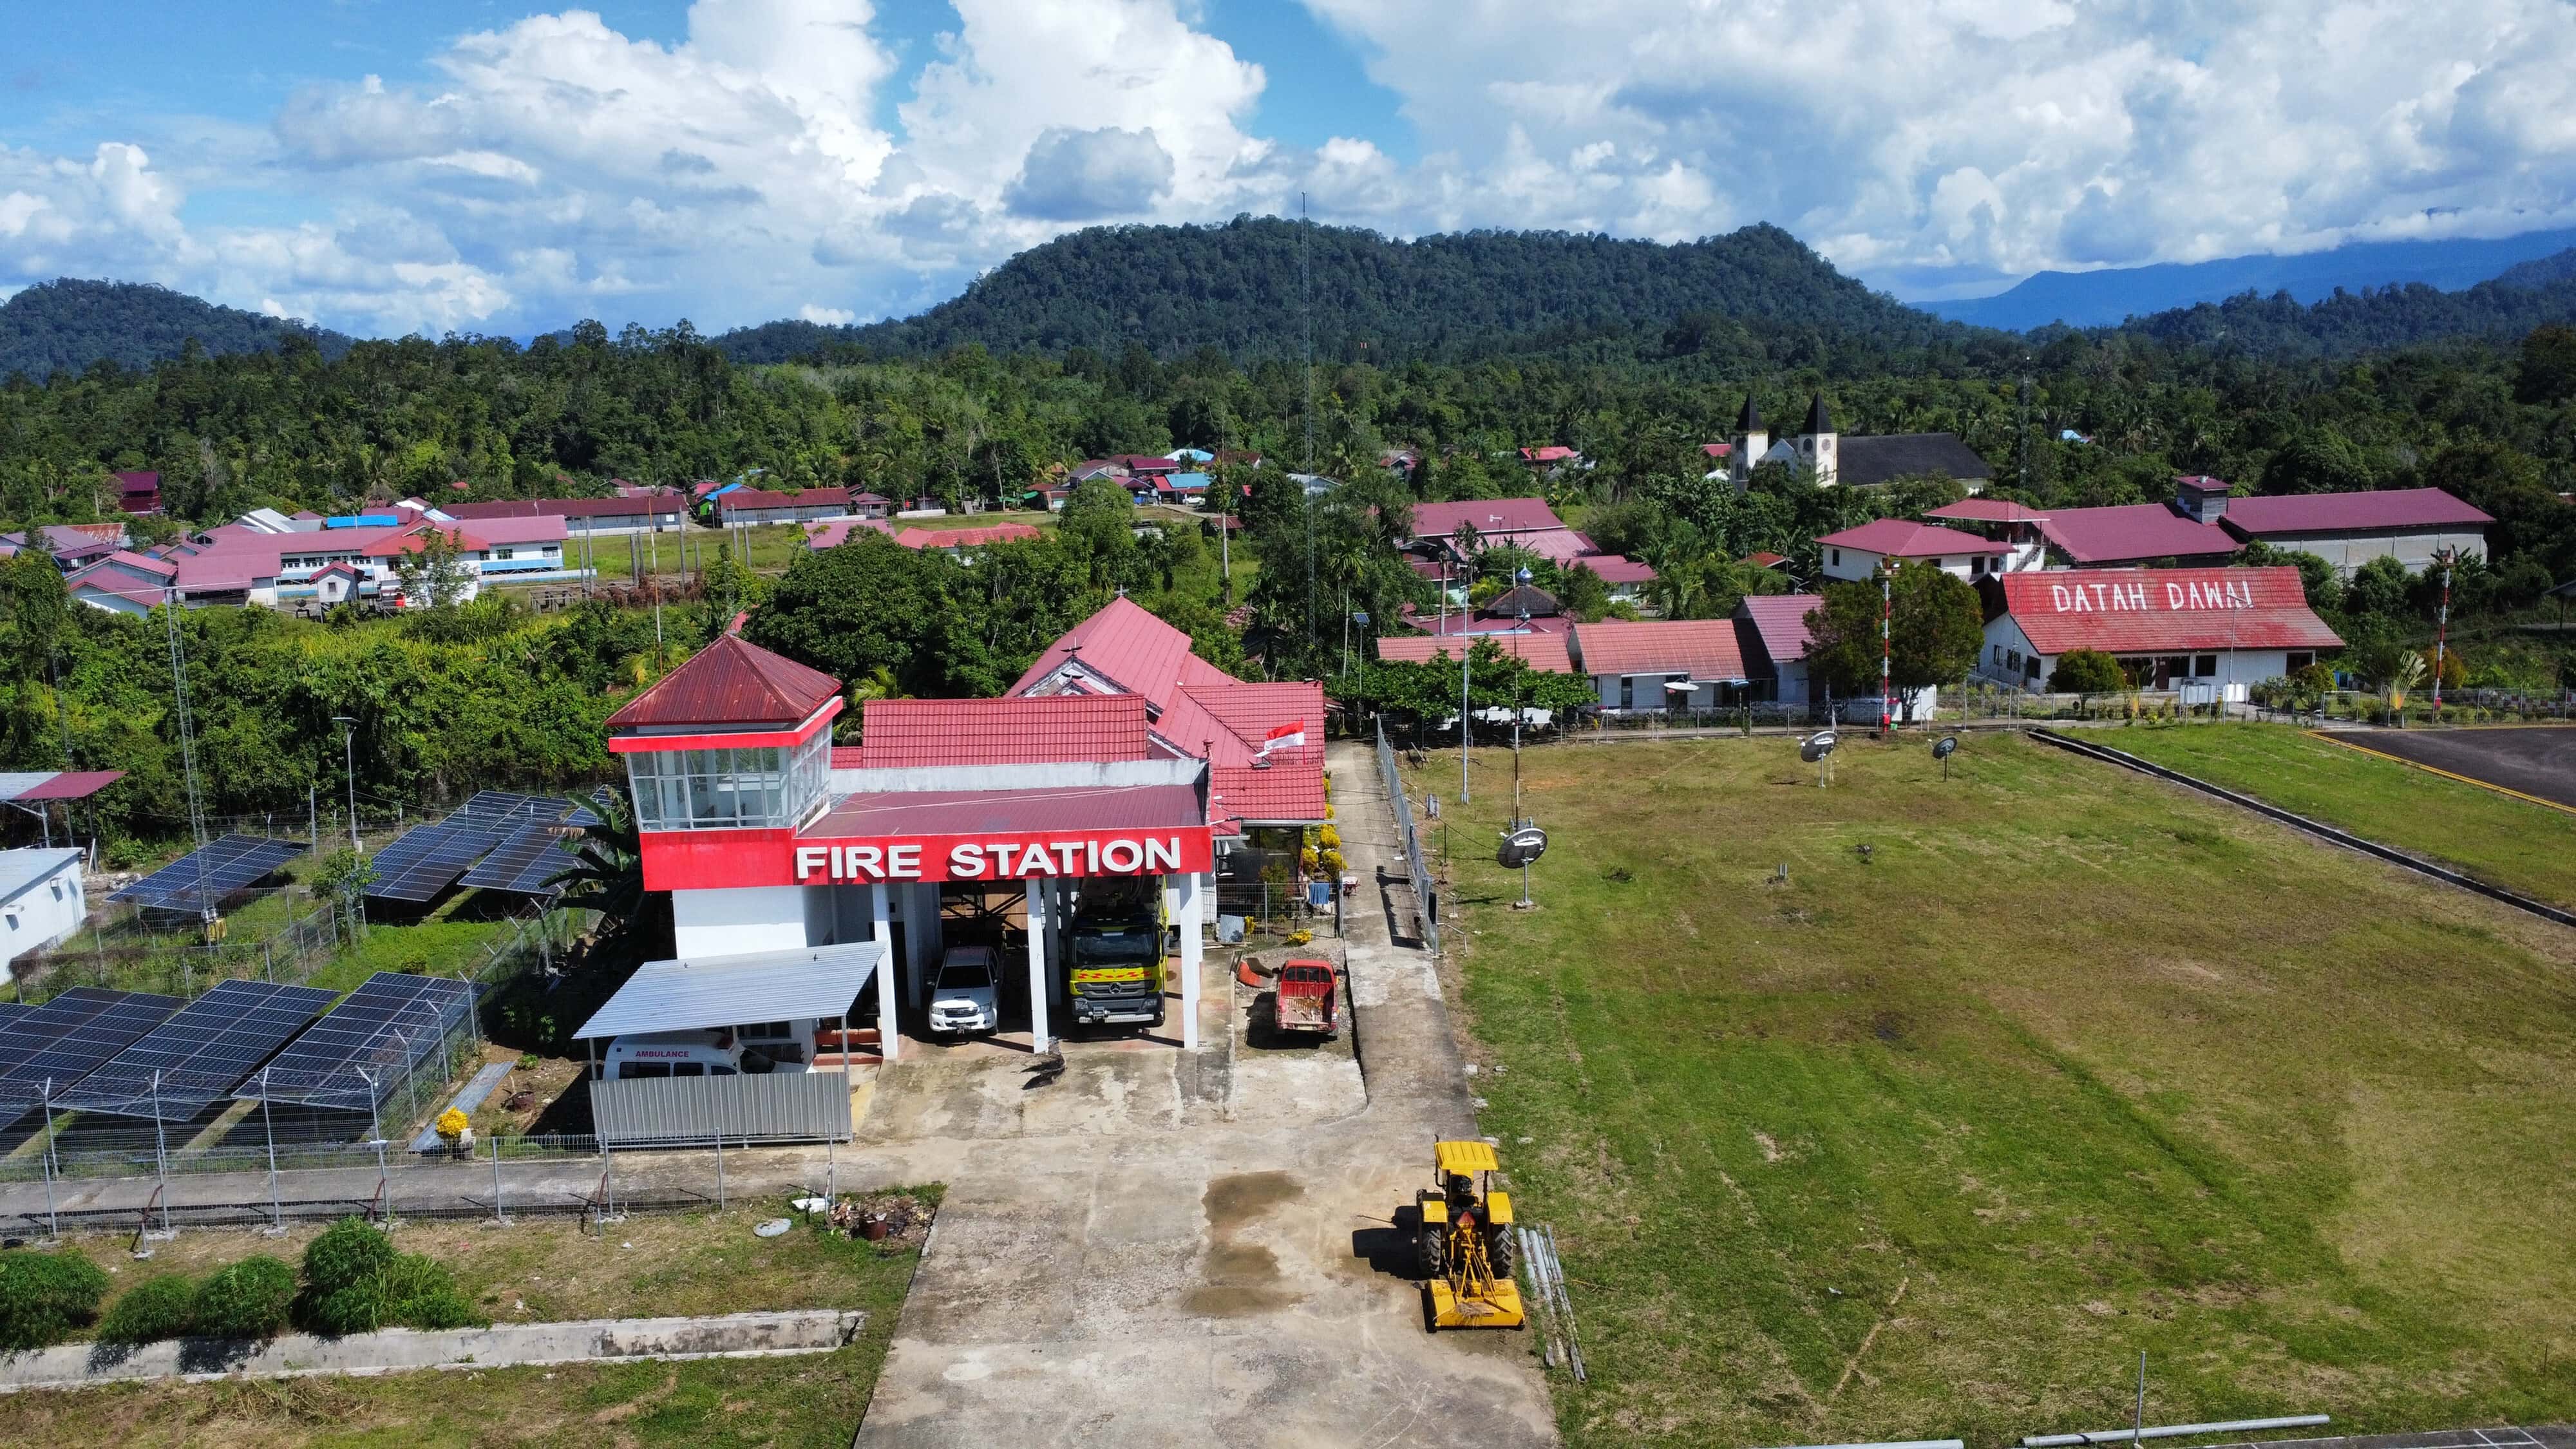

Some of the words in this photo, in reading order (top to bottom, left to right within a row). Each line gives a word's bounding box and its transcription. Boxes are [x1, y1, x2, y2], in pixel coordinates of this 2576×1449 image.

[2052, 583, 2147, 612] DATAH
[2166, 581, 2254, 610] DAWAI
[796, 845, 922, 879] FIRE
[949, 837, 1180, 876] STATION
